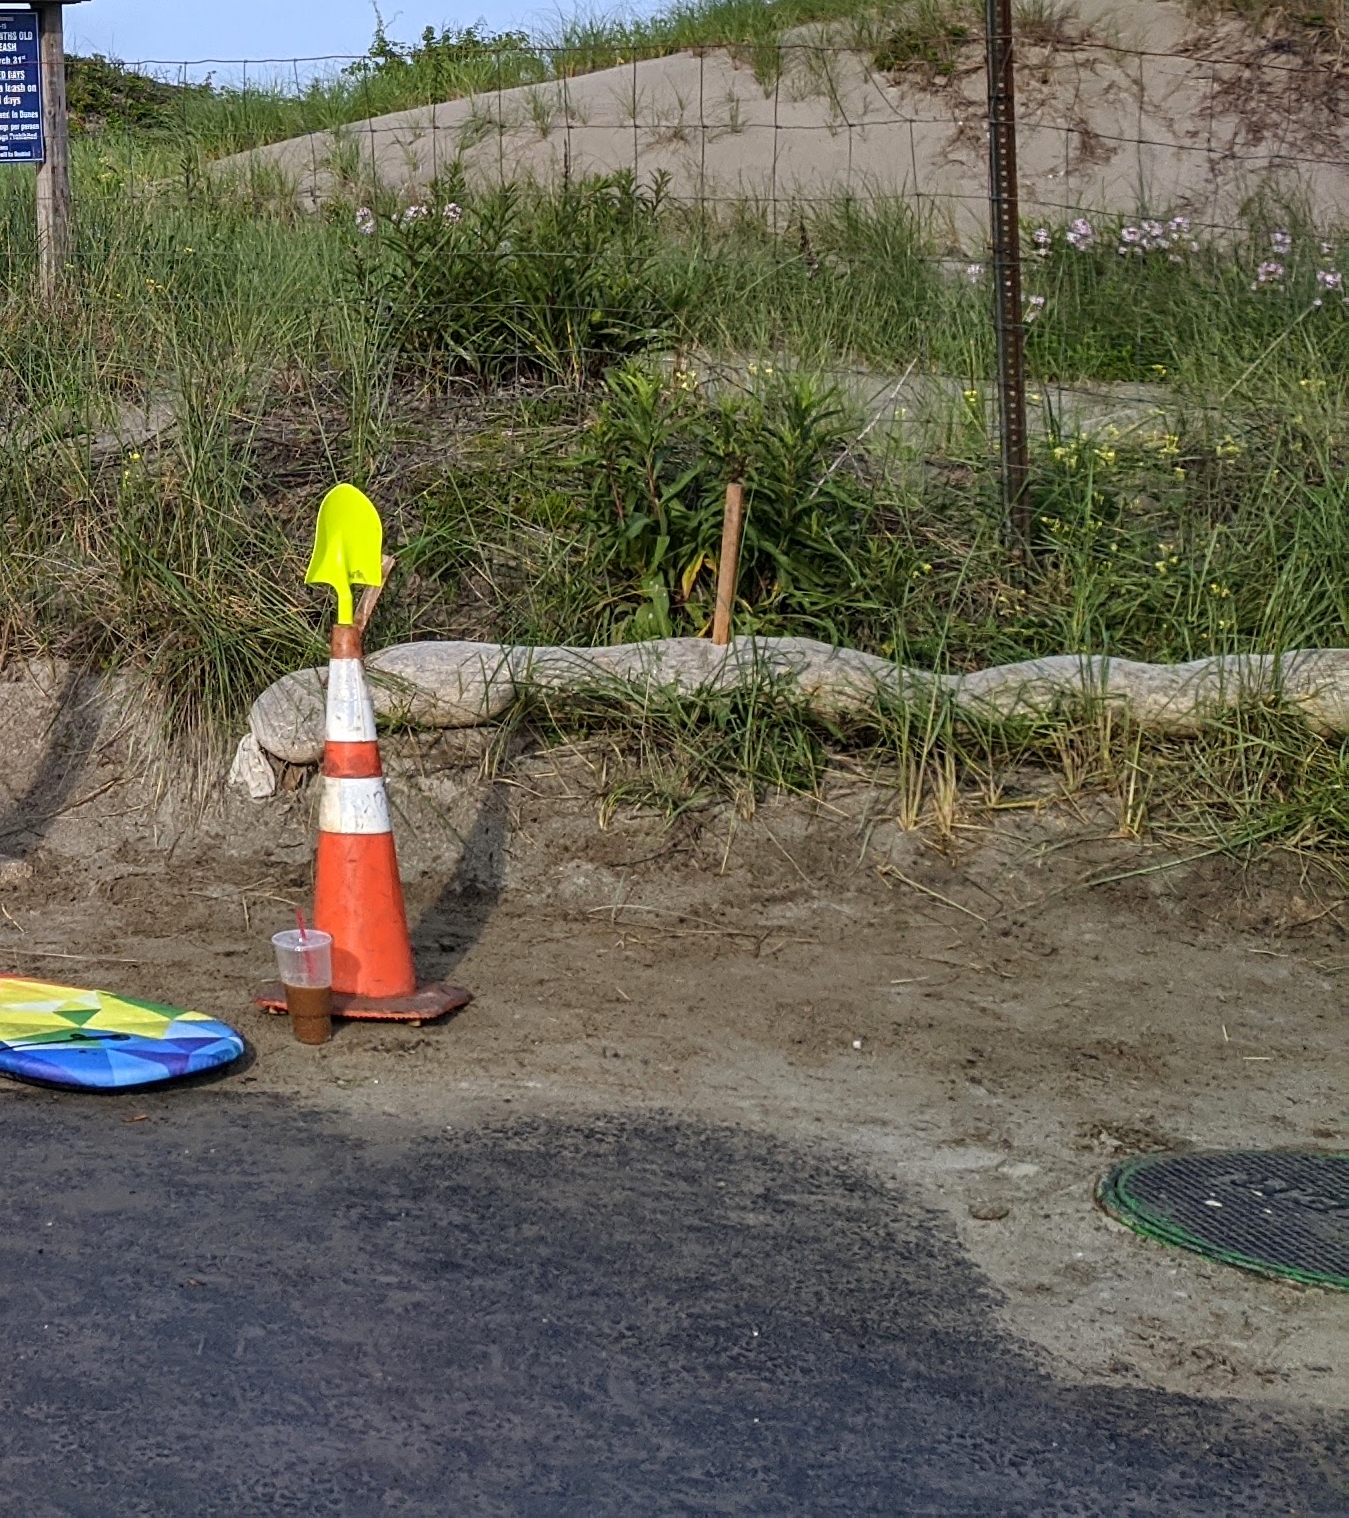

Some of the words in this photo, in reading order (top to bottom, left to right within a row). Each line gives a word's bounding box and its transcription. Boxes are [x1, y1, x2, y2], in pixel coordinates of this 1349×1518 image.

[19, 31, 32, 40] OLD
[8, 70, 24, 79] DAYS
[5, 83, 25, 92] leash
[4, 96, 21, 106] days
